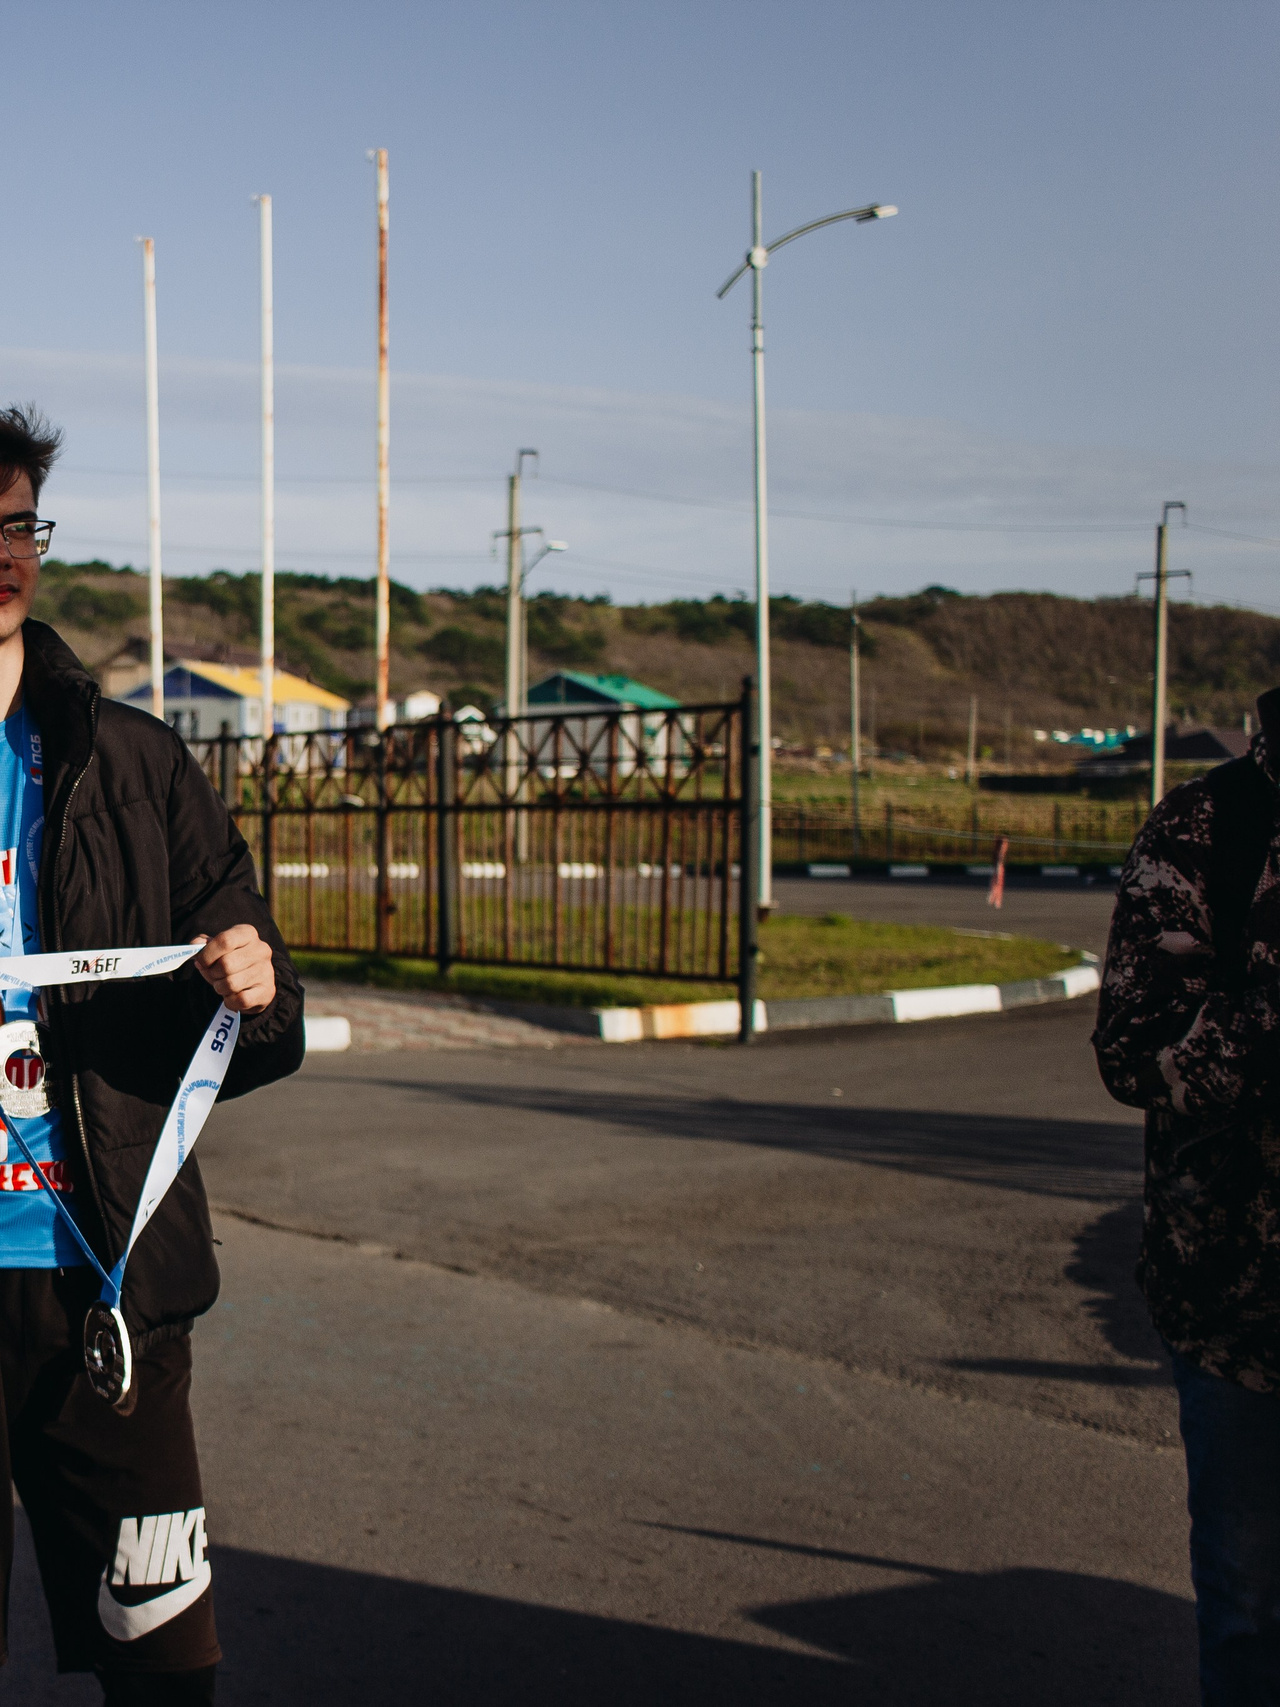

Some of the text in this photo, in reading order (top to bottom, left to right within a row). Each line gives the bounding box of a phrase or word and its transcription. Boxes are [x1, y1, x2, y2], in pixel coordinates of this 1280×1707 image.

[30, 734, 42, 765] ПСБ
[71, 957, 121, 974] ЗА БЕГ
[210, 1014, 235, 1053] ПСБ
[111, 1507, 210, 1585] NIKE
